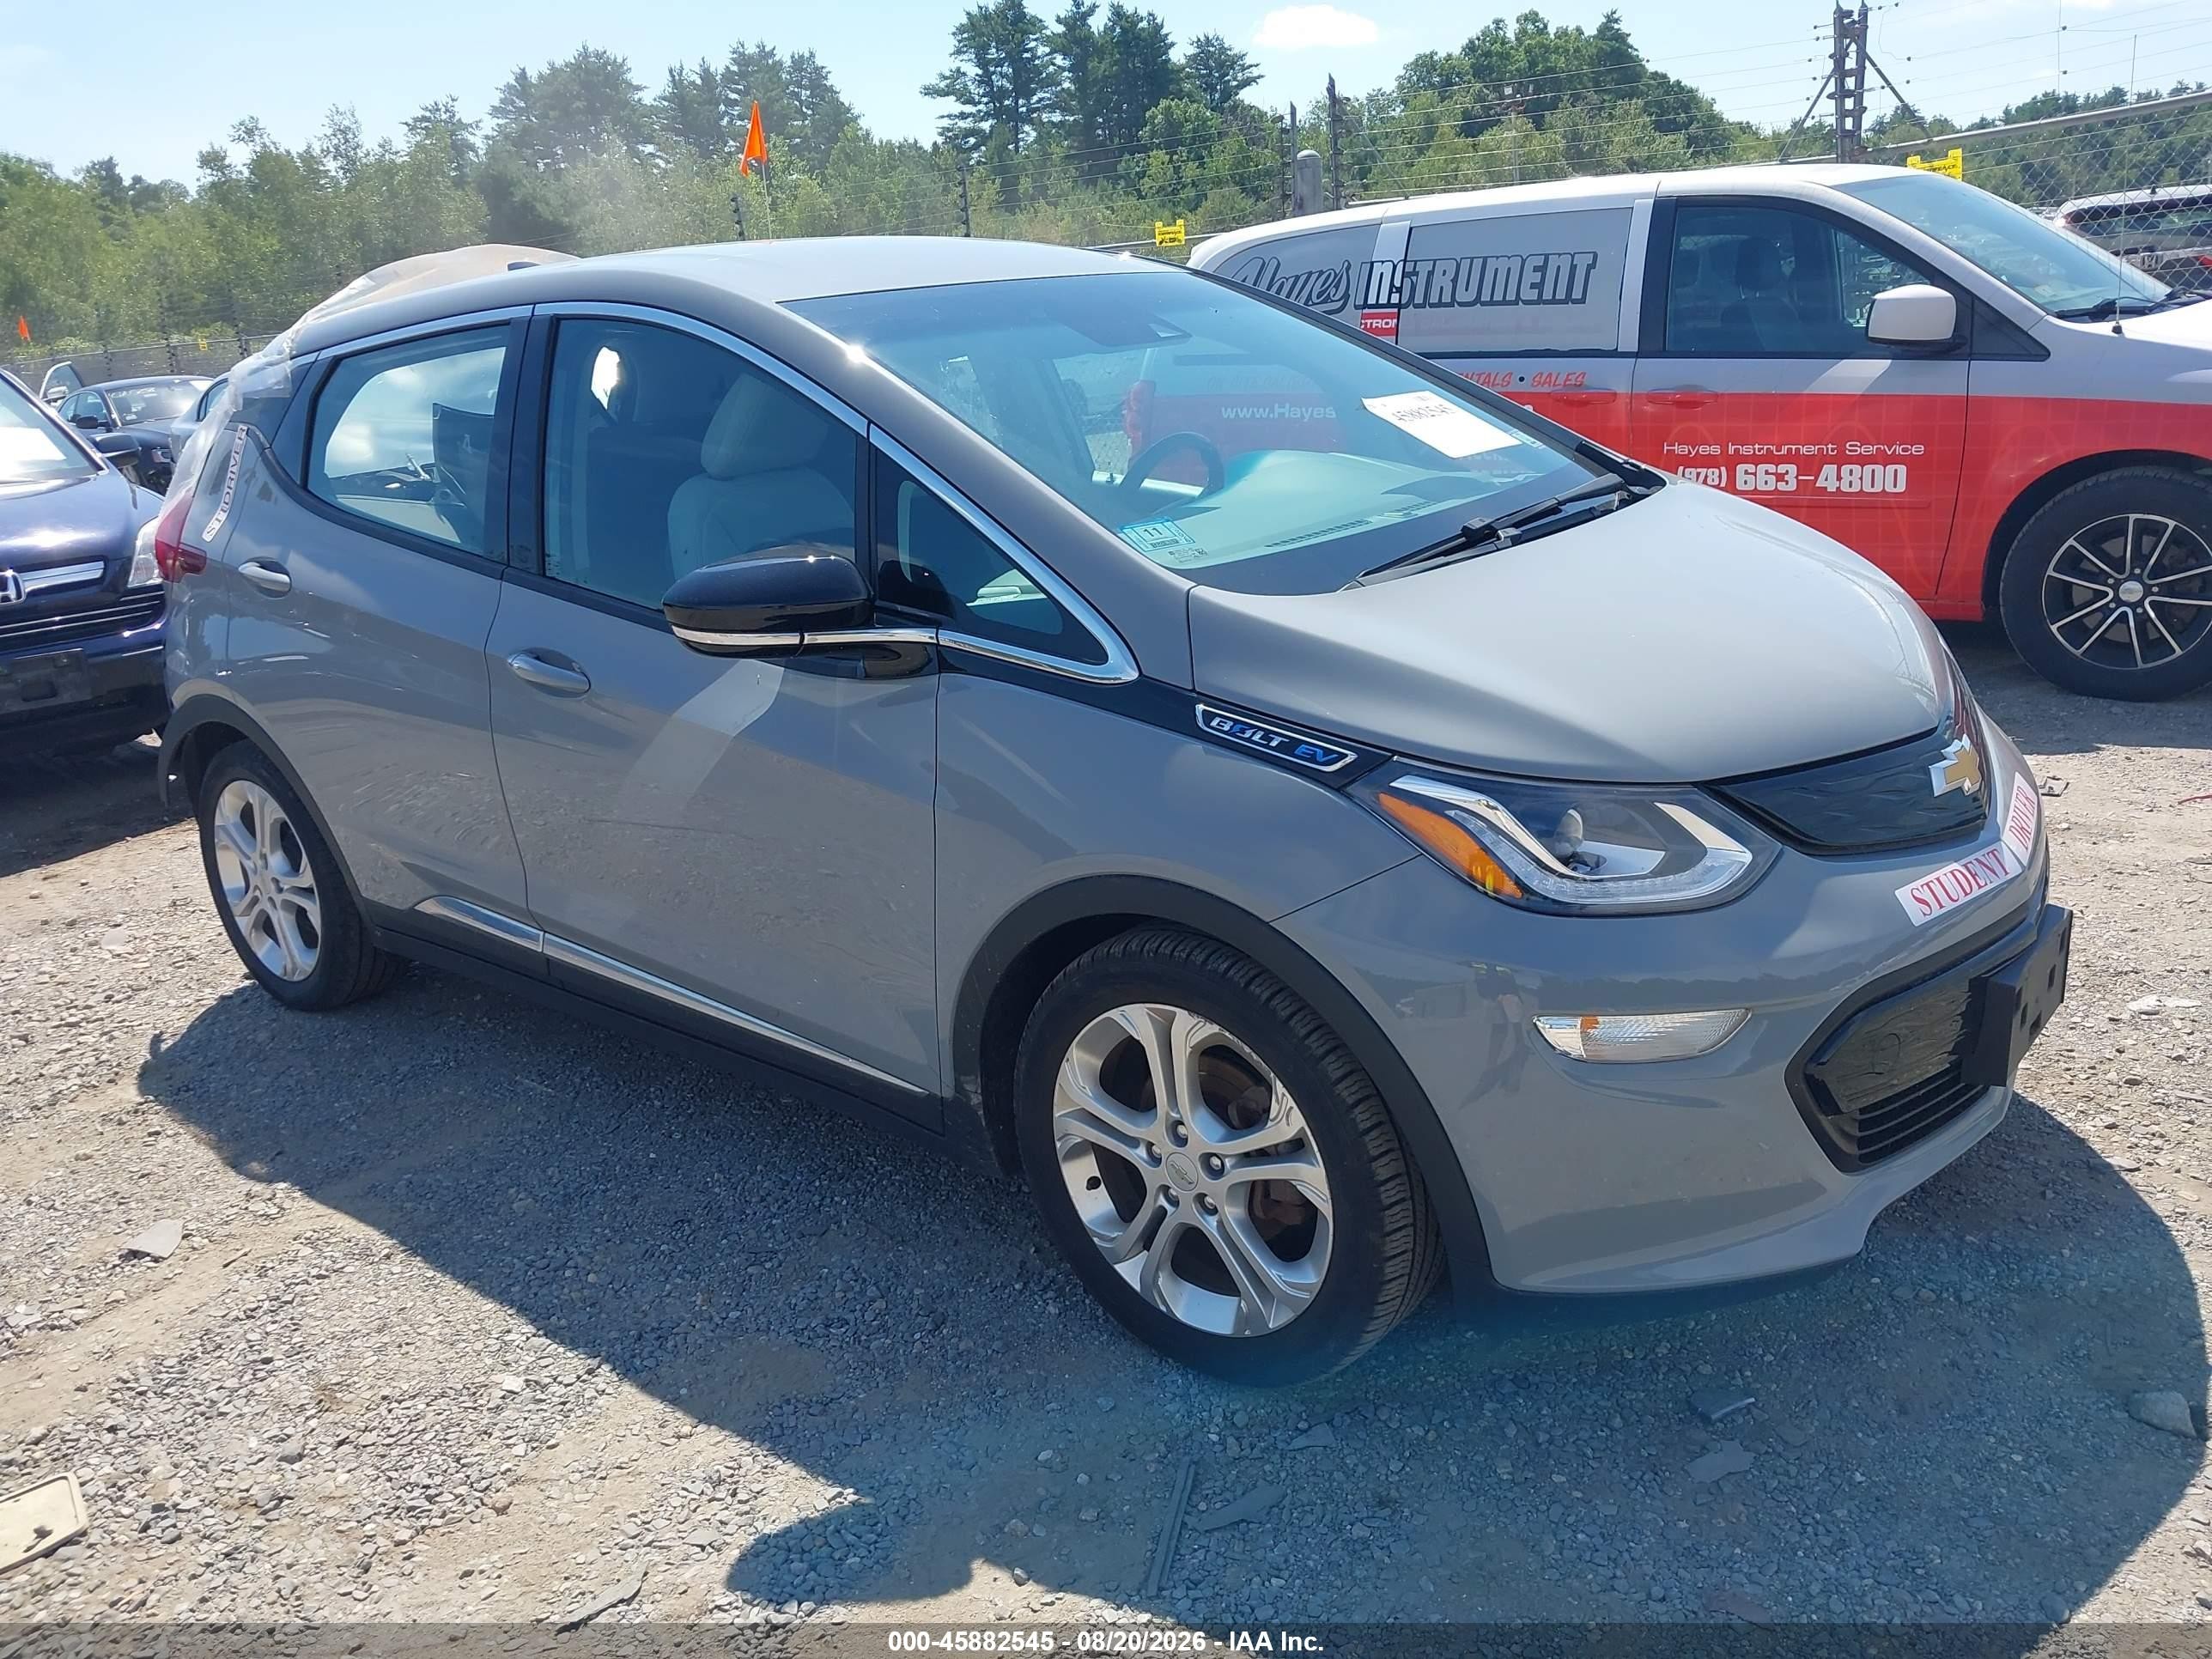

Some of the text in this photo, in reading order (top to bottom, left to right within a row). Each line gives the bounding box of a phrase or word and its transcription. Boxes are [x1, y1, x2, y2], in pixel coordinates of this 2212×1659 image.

[1353, 252, 1598, 310] INSTRUMENT
[1460, 371, 1587, 387] NTALS SALES
[222, 427, 246, 505] DRIVER
[1663, 441, 1925, 458] Hayes Instrument Service
[1735, 463, 1907, 493] 663-4800
[1209, 716, 1339, 763] BOLT EV
[2008, 785, 2037, 853] DRIVER
[1911, 848, 2010, 918] STUDENT
